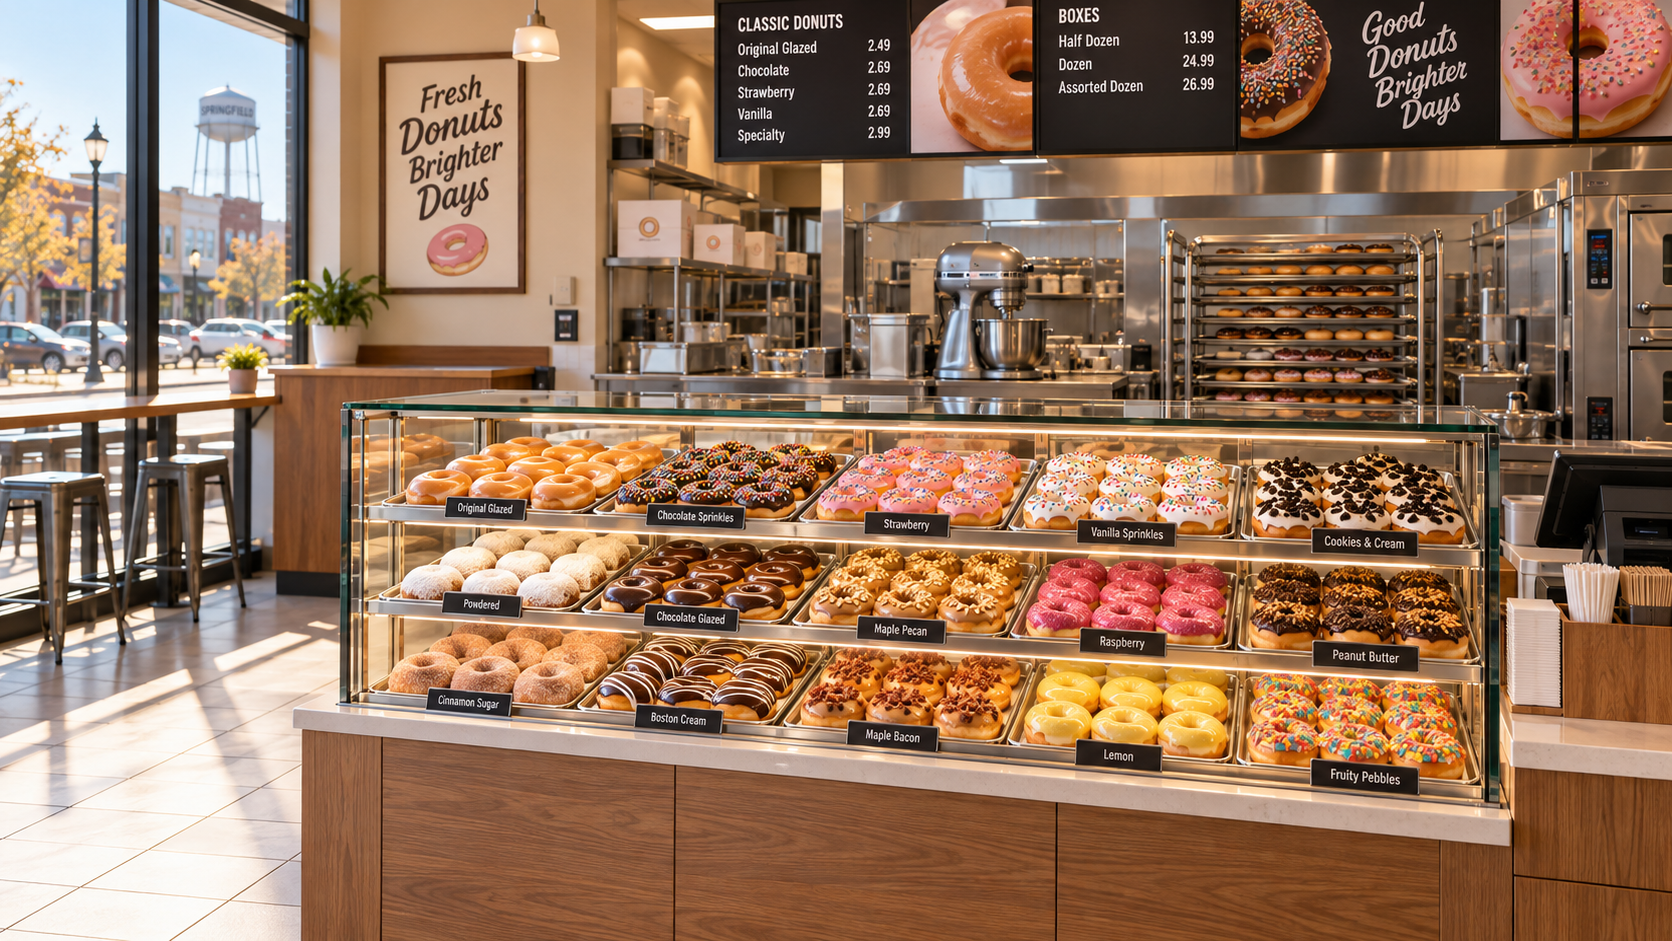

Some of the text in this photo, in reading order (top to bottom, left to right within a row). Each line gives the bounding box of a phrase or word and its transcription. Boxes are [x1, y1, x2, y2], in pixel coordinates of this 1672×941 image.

[738, 13, 843, 32] CLASSIC DONUTS
[1059, 7, 1100, 24] BOXES
[1362, 1, 1426, 45] Good
[1059, 30, 1214, 48] Half Dozen 13.99
[738, 38, 890, 58] Original Glazed 2.49
[1367, 24, 1458, 79] Donuts
[738, 60, 890, 77] Chocolate 2.69
[1059, 54, 1214, 71] Dozen 24.99
[420, 74, 482, 113] Fresh
[738, 82, 890, 101] Strawberry 2.69
[1058, 77, 1214, 94] Assorted Dozen 26.99
[1375, 61, 1468, 109] Brighter
[201, 105, 254, 118] SPRINGFIELD
[737, 104, 890, 120] Vanilla 2.69
[1401, 92, 1461, 130] Days
[399, 99, 503, 156] Donuts
[738, 126, 890, 144] Specialty 2.99
[409, 141, 504, 184] Brighter
[417, 177, 490, 221] Days
[458, 502, 513, 515] Original Glazed
[657, 510, 734, 523] Chocolate Sprinkles
[884, 519, 930, 532] Strawberry
[1091, 527, 1164, 541] Vanilla Sprinkles
[1325, 535, 1405, 549] Cookies & Cream
[463, 599, 500, 610] Powdered
[657, 611, 725, 624] Chocolate Glazed
[874, 623, 927, 637] Maple Pecan
[1100, 636, 1145, 651] Raspberry
[1333, 649, 1400, 663] Peanut Butter
[438, 695, 499, 711] Cinnamon Sugar
[651, 712, 706, 726] Boston Cream
[865, 729, 920, 743] Maple Bacon
[1104, 749, 1134, 762] Lemon
[1331, 768, 1400, 785] Fruity Pebbles
